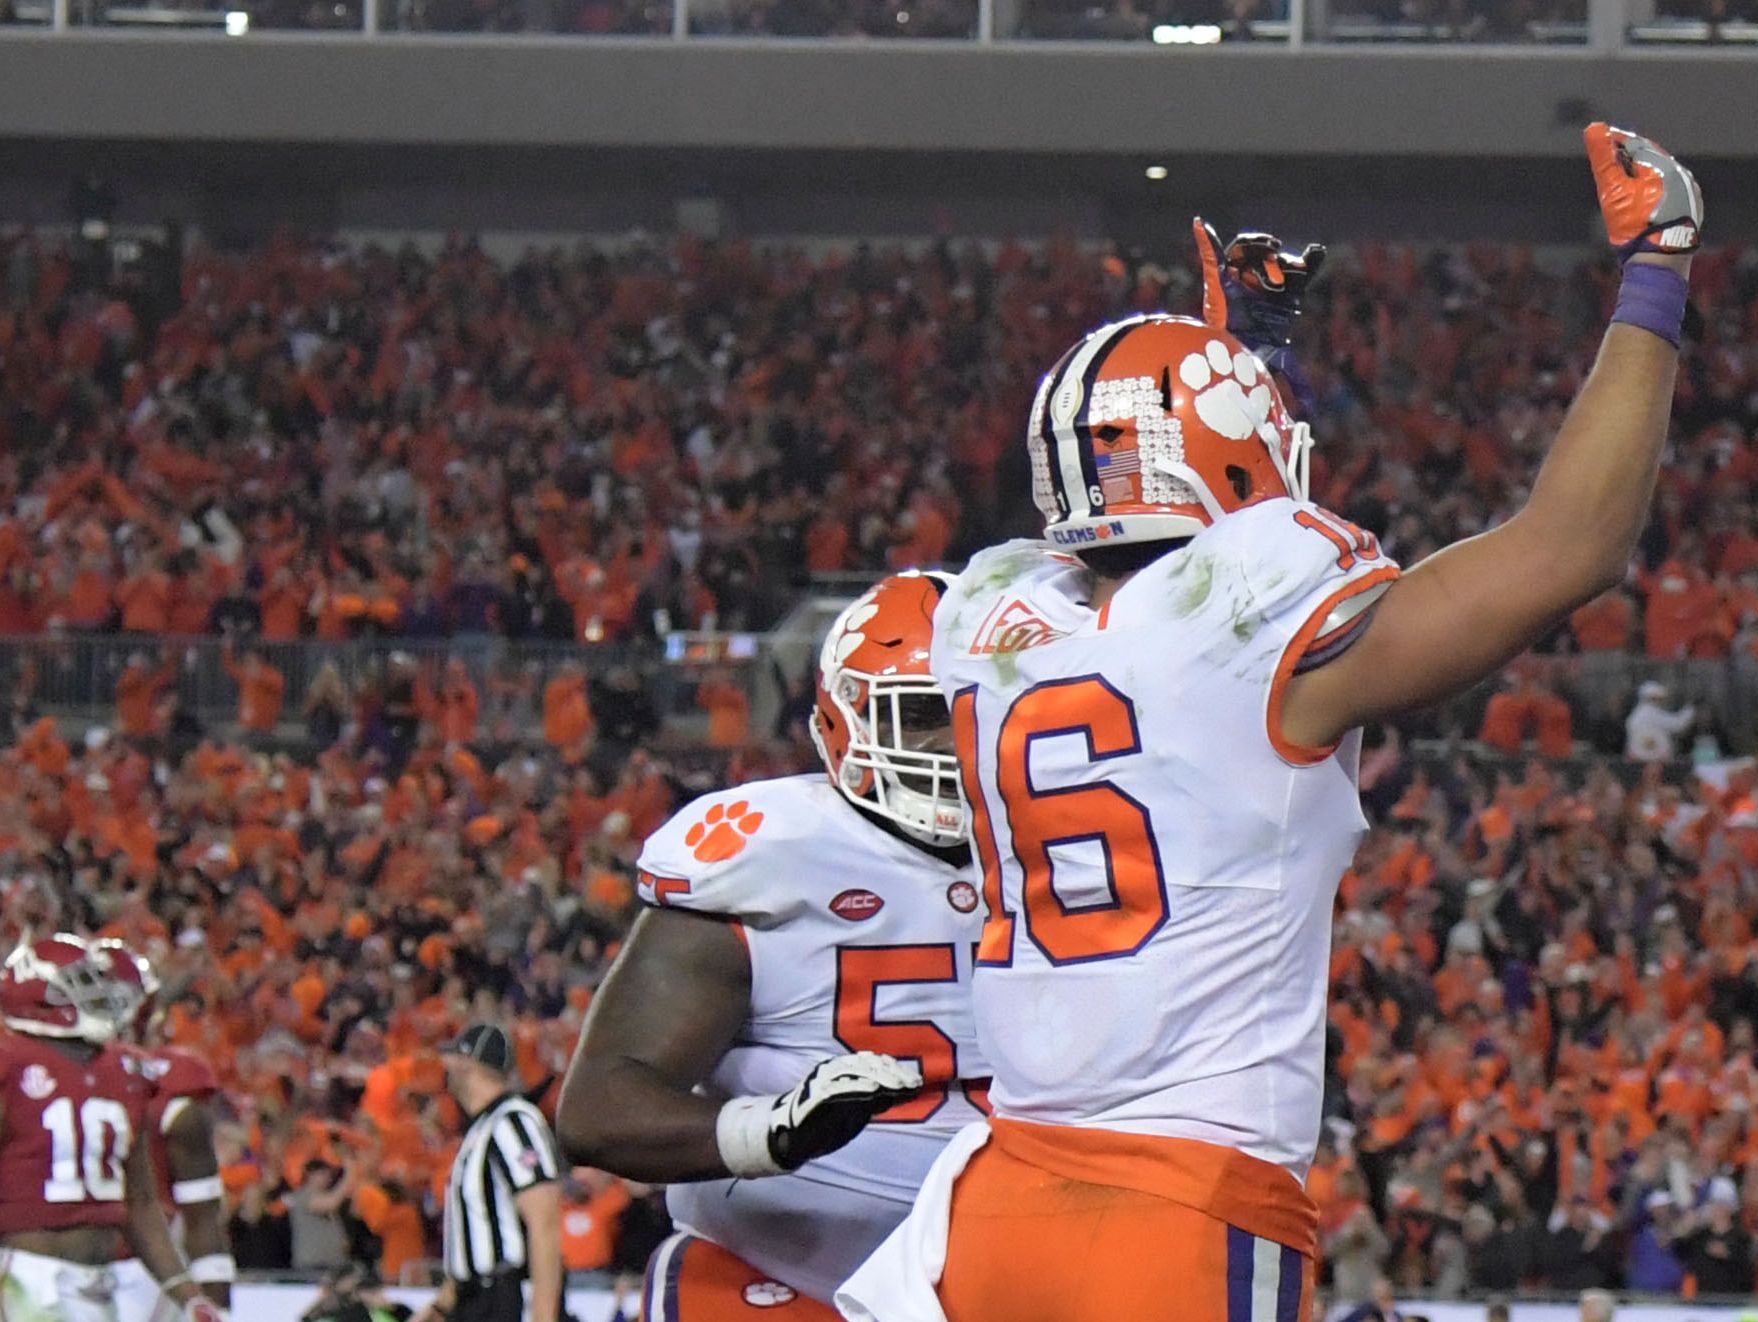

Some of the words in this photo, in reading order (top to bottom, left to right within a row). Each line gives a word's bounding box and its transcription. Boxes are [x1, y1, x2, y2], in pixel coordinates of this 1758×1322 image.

[1660, 225, 1695, 248] NIKE
[952, 673, 1170, 967] 16
[837, 894, 876, 912] ACC
[41, 1096, 132, 1203] 10
